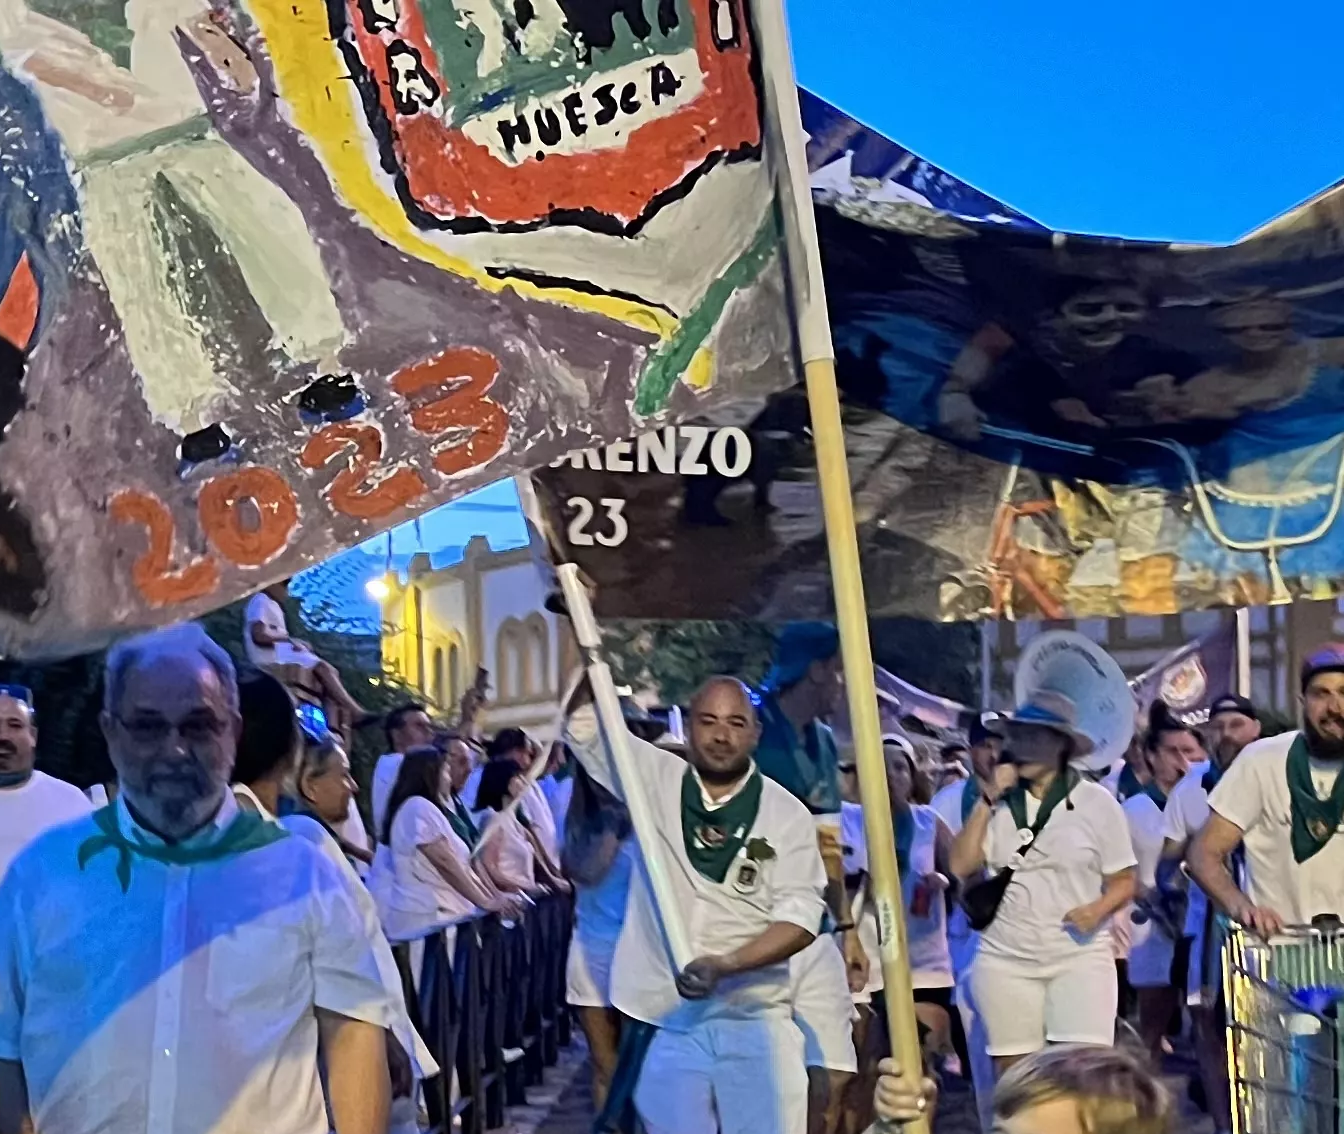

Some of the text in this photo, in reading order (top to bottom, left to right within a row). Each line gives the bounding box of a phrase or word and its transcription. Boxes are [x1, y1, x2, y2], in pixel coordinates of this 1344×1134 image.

[497, 62, 682, 152] HUESCA
[108, 345, 511, 606] 2023
[549, 426, 752, 478] ENZO
